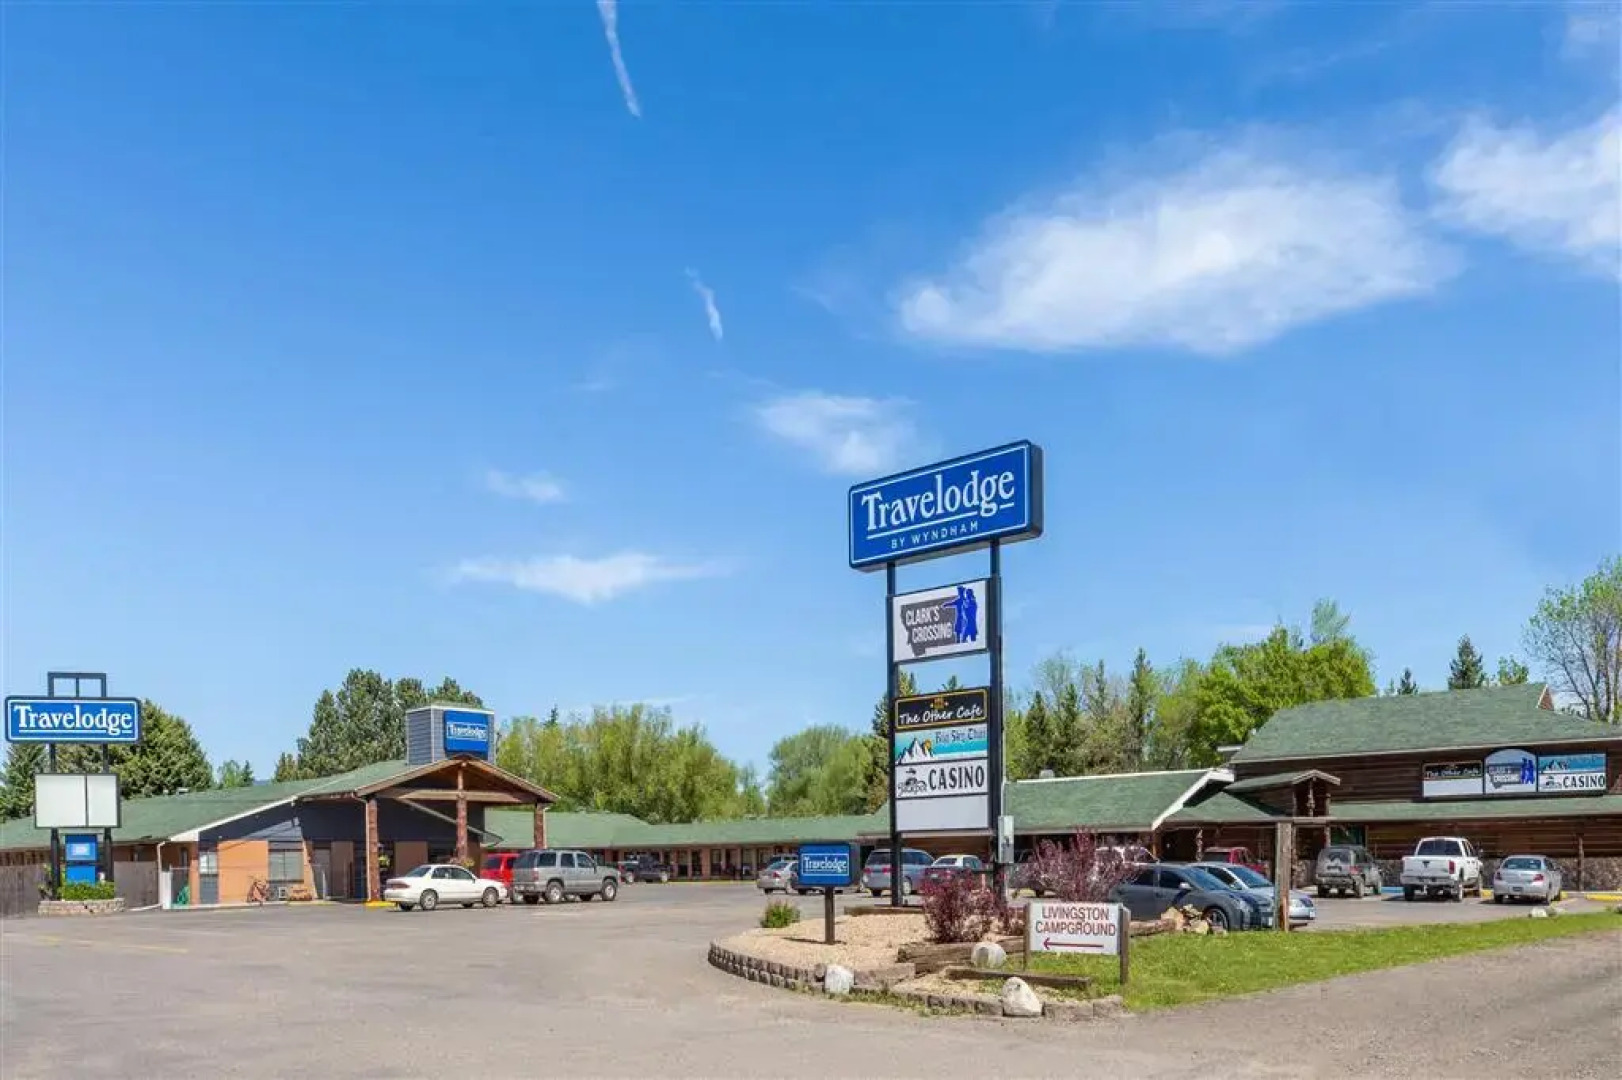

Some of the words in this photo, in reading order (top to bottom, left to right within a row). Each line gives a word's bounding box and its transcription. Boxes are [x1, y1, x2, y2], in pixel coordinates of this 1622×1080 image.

[861, 470, 1015, 531] Travelodge
[891, 538, 905, 549] BY
[912, 521, 979, 544] WYNDHAM
[905, 606, 940, 626] CLARK'S
[911, 623, 953, 644] CROSSING
[13, 704, 133, 735] Travelodge
[900, 713, 920, 725] The
[923, 709, 953, 722] Other
[928, 765, 985, 791] CASINO
[1563, 775, 1606, 788] CASINO
[804, 856, 847, 873] Travelodge
[1042, 906, 1109, 920] LIVINGSTON
[1036, 921, 1116, 936] CAMPGROUND
